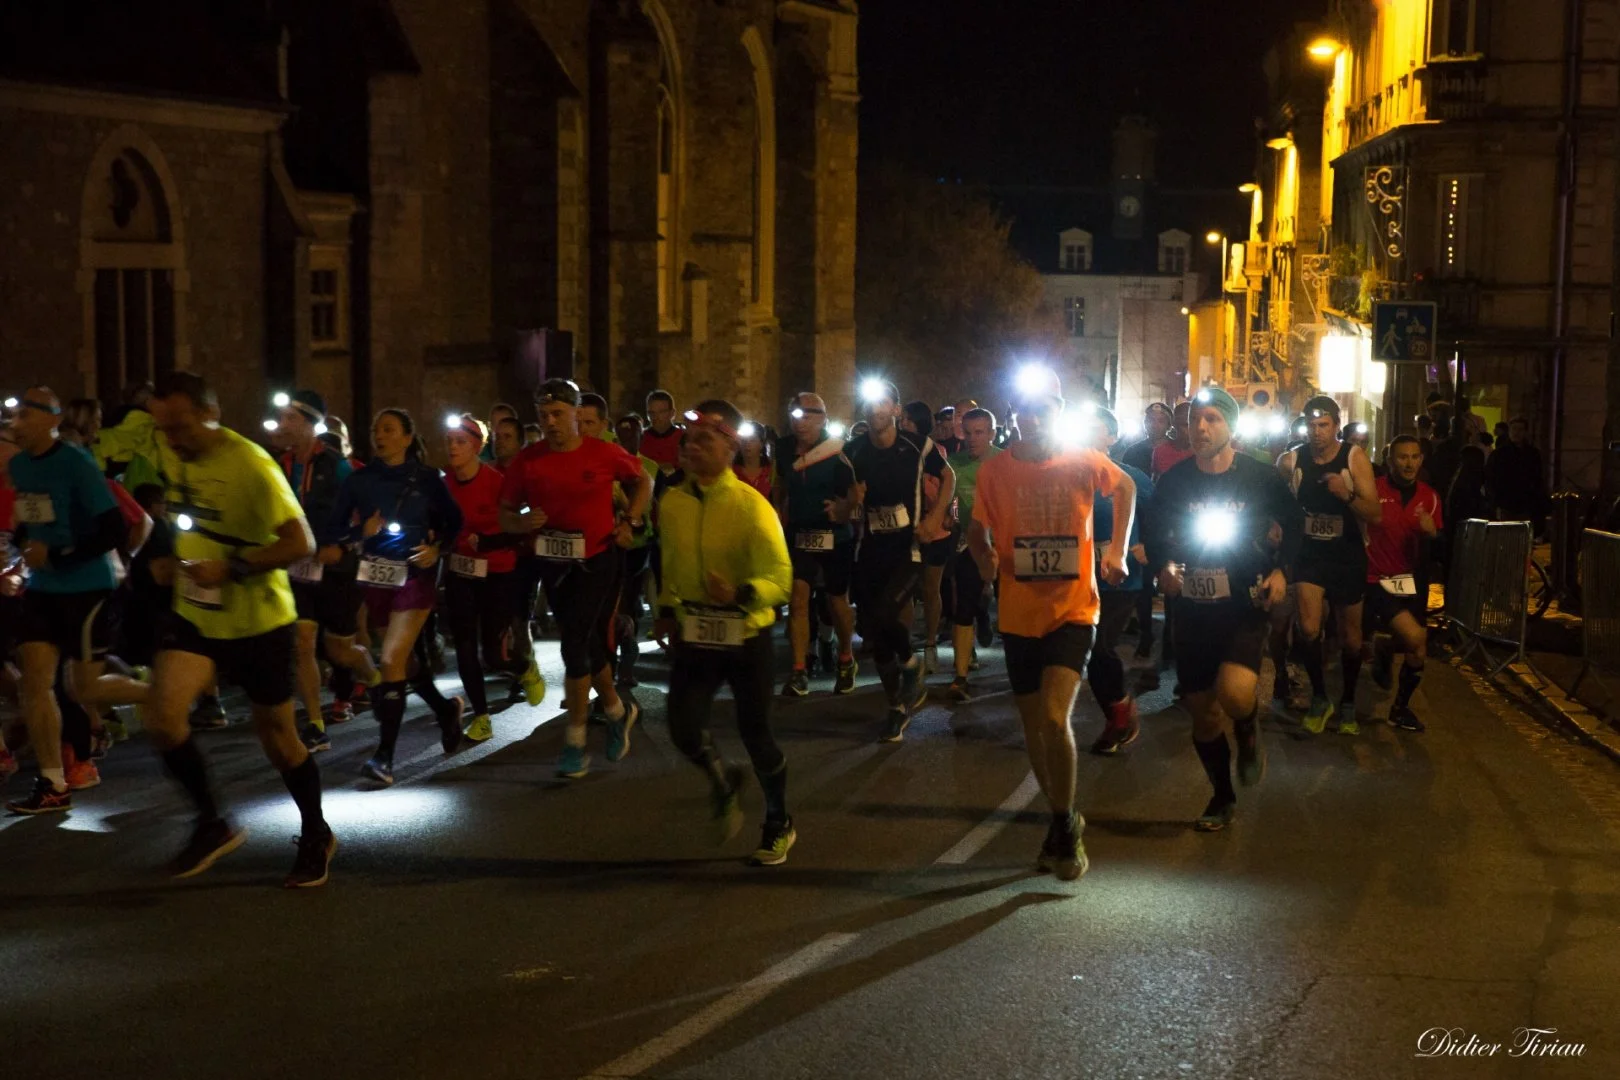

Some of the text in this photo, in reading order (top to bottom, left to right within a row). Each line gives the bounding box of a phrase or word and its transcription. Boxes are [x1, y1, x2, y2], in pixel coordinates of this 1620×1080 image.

[545, 538, 575, 557] 1081
[803, 535, 825, 549] 882
[1031, 550, 1062, 573] 132
[368, 564, 397, 583] 352
[1188, 577, 1216, 597] 350
[1391, 580, 1404, 592] 74
